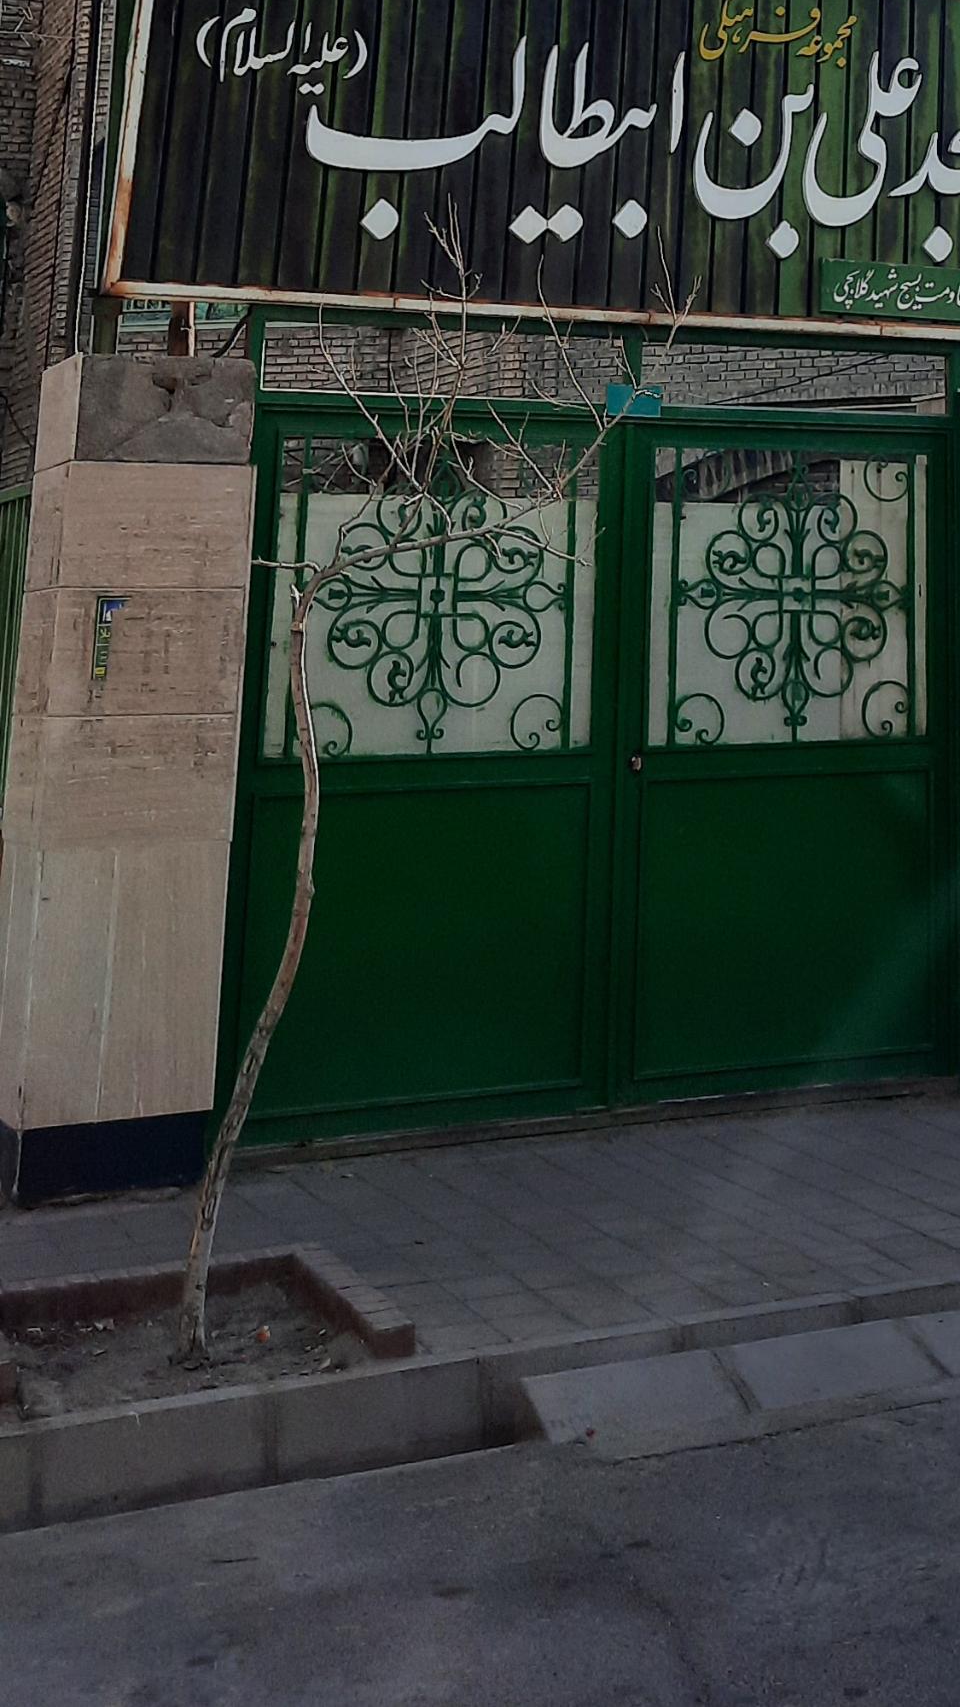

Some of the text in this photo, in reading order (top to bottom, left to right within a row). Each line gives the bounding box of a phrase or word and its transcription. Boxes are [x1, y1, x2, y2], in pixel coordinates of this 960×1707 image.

[796, 14, 858, 69] مجموعه
[802, 50, 923, 227] علی
[692, 83, 815, 260] بن
[864, 268, 899, 308] شهید
[896, 272, 922, 311] بسیج
